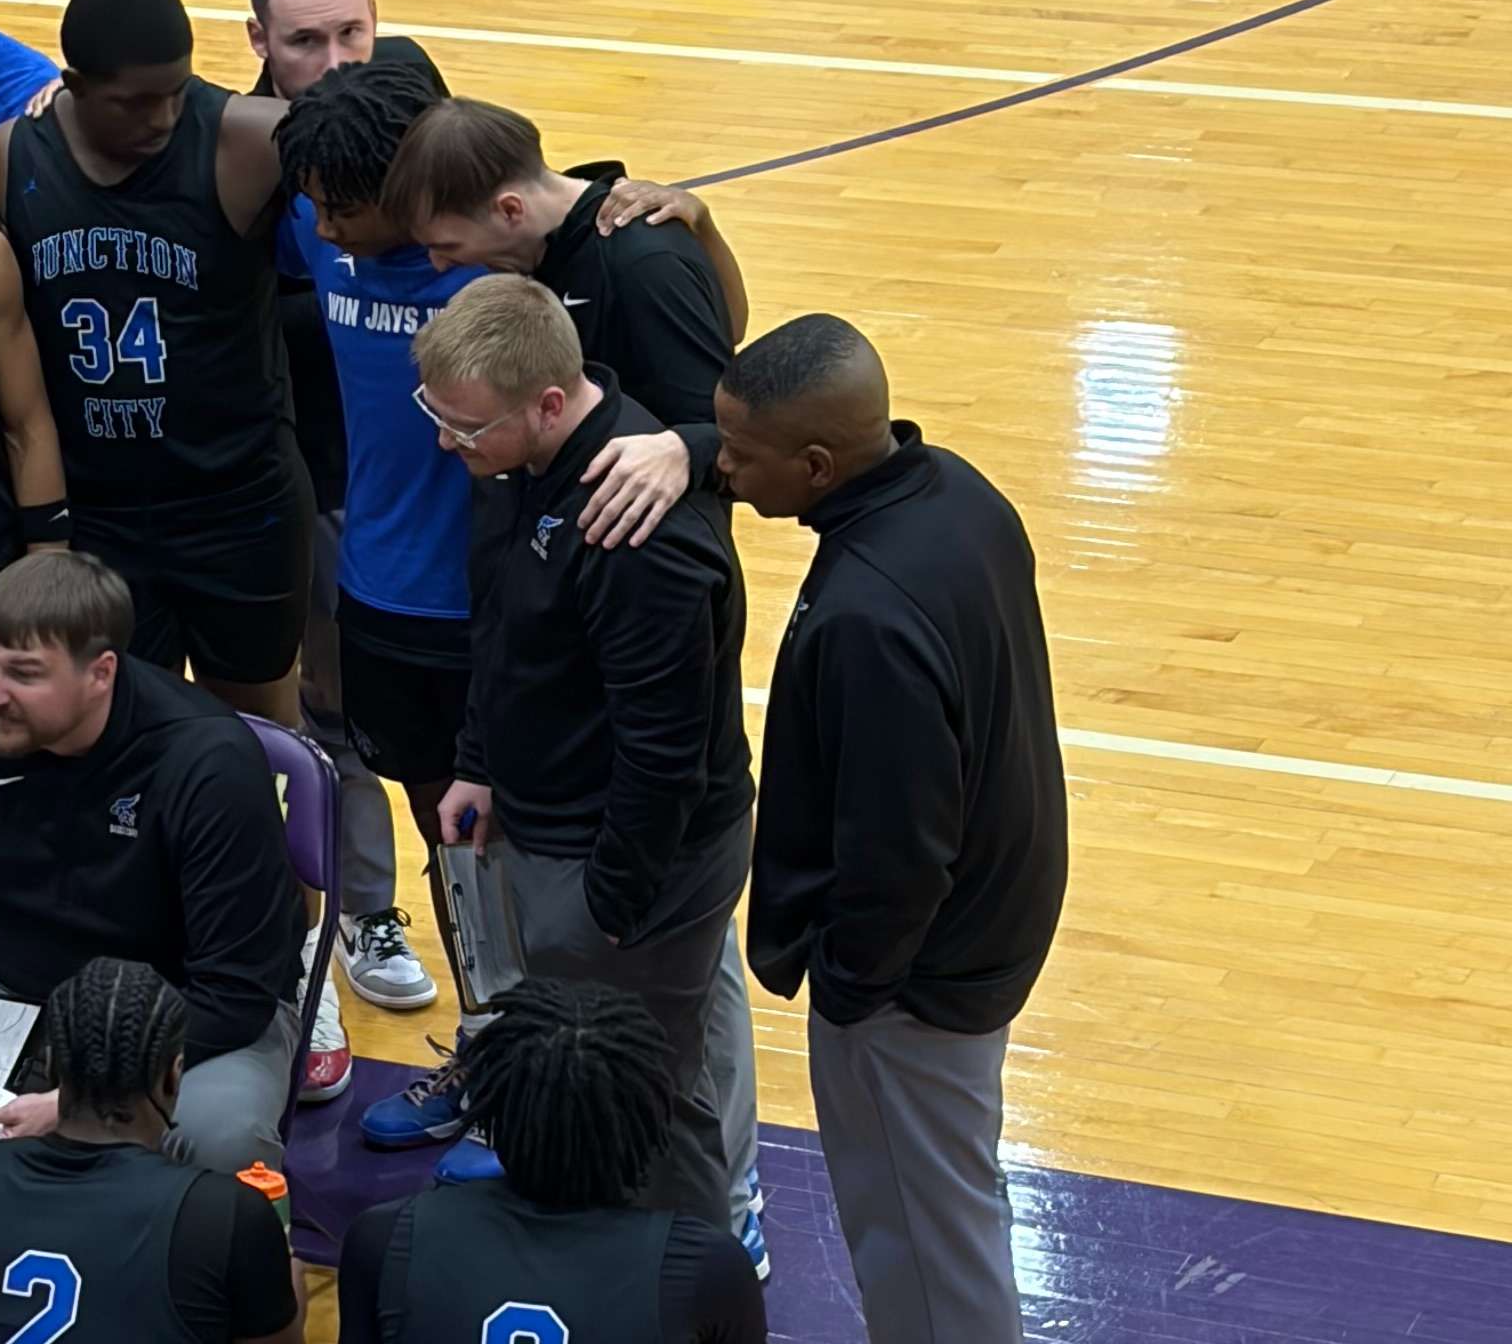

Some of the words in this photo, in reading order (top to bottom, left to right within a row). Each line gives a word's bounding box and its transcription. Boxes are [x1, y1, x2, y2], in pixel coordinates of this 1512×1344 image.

[328, 292, 359, 327] WIN
[365, 302, 419, 334] JAYS
[61, 297, 167, 384] 34
[84, 397, 166, 438] CITY
